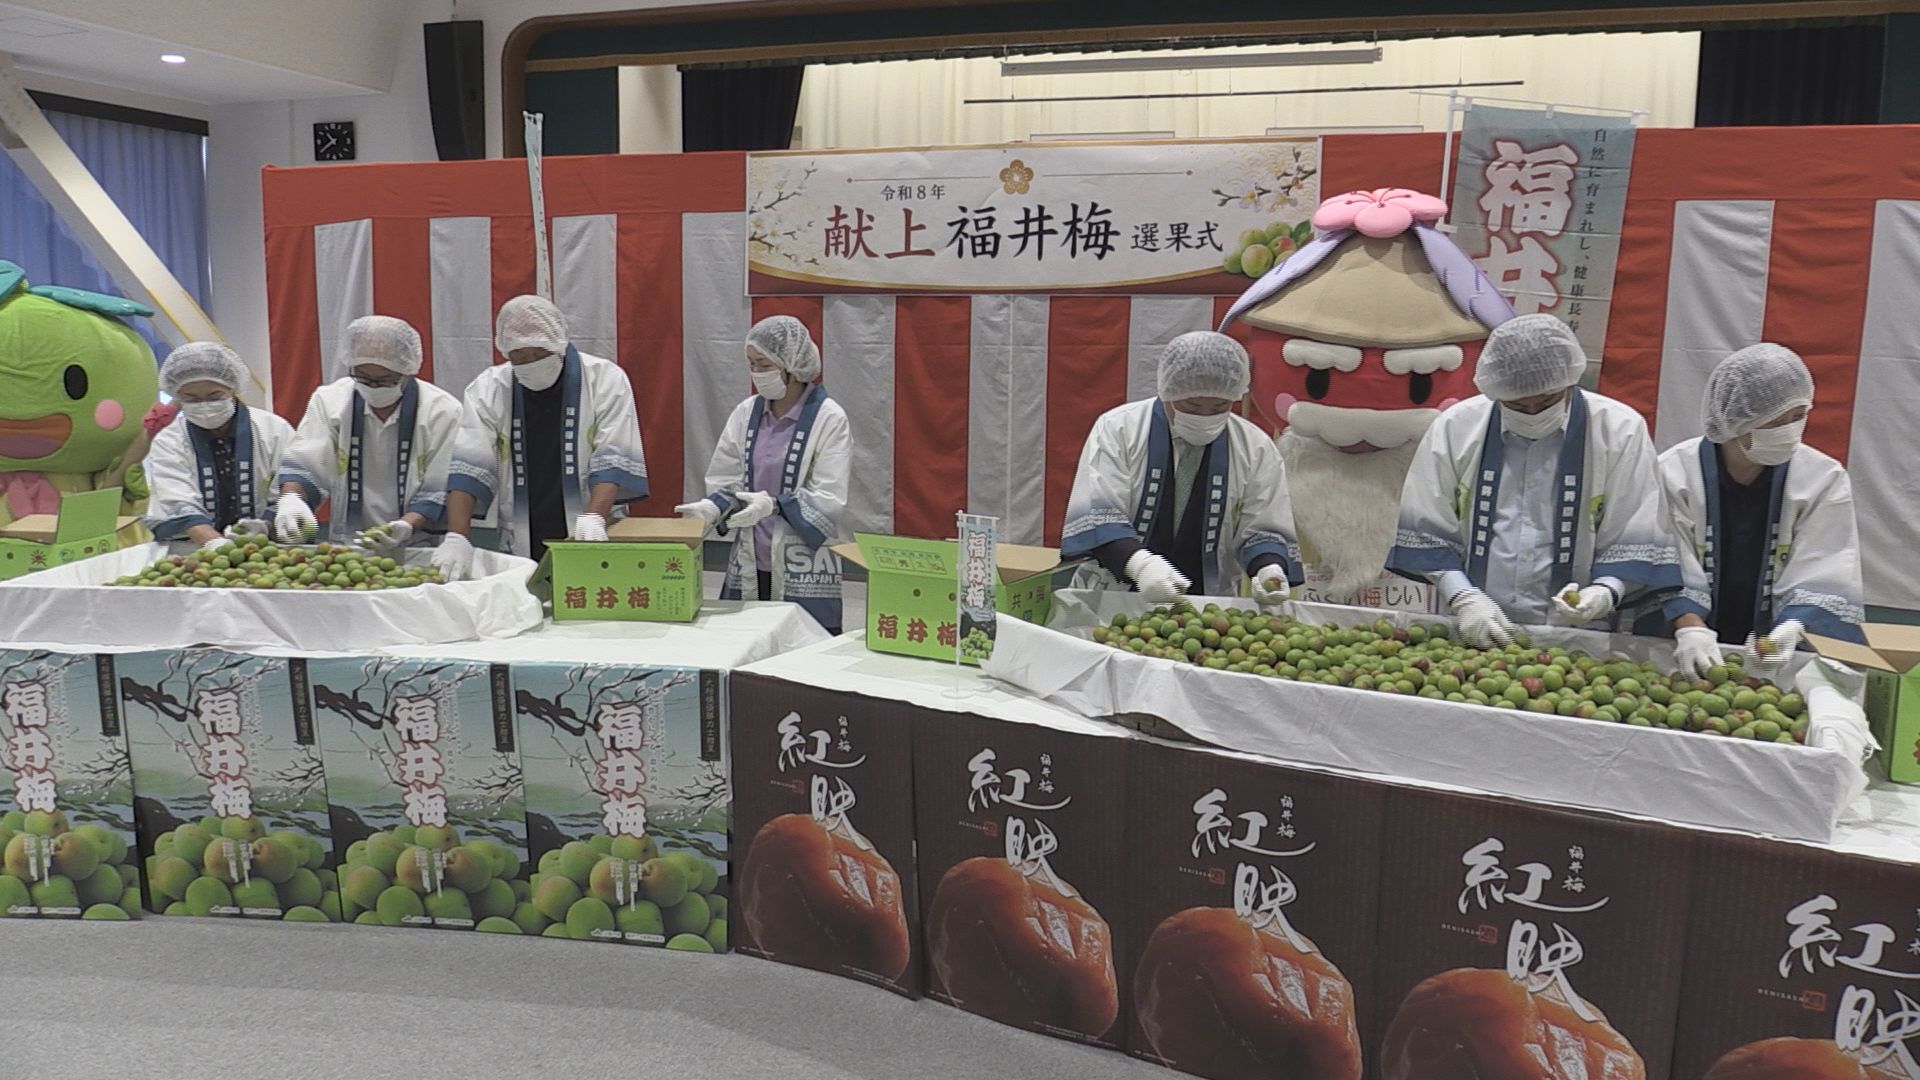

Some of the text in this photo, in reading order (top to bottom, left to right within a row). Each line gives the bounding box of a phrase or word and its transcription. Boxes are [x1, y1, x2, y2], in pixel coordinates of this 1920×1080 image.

[881, 184, 946, 201] 令和8年
[564, 586, 651, 609] 福井梅
[966, 531, 988, 609] 福井梅
[876, 613, 957, 648] 福井梅
[3, 682, 59, 814] 福井梅
[198, 688, 254, 819] 福井梅
[394, 696, 449, 829] 福井梅
[598, 703, 648, 840] 福井梅
[1276, 795, 1297, 839] 福井梅
[1562, 845, 1586, 893] 福井梅
